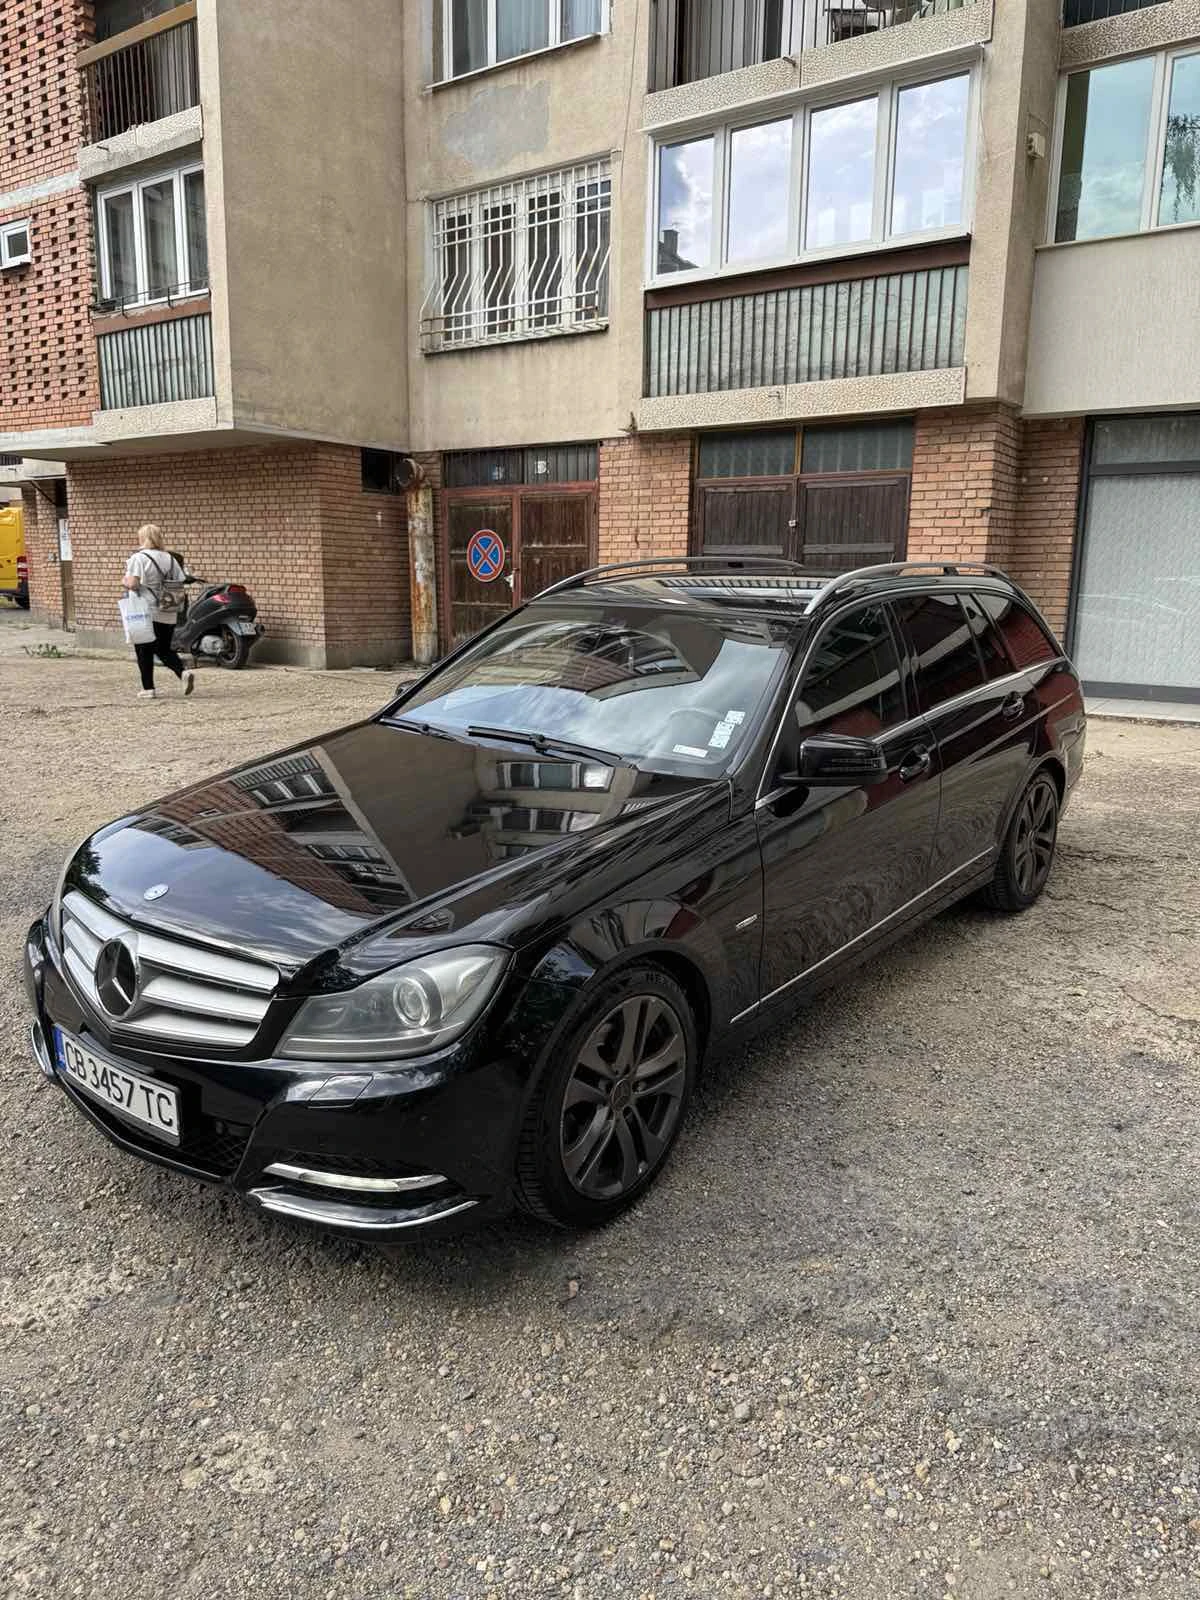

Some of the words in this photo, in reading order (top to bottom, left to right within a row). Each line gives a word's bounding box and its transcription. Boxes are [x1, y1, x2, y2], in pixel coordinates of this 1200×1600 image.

[65, 1041, 87, 1081] CB
[88, 1058, 134, 1108] 3457
[139, 1084, 173, 1127] TC
